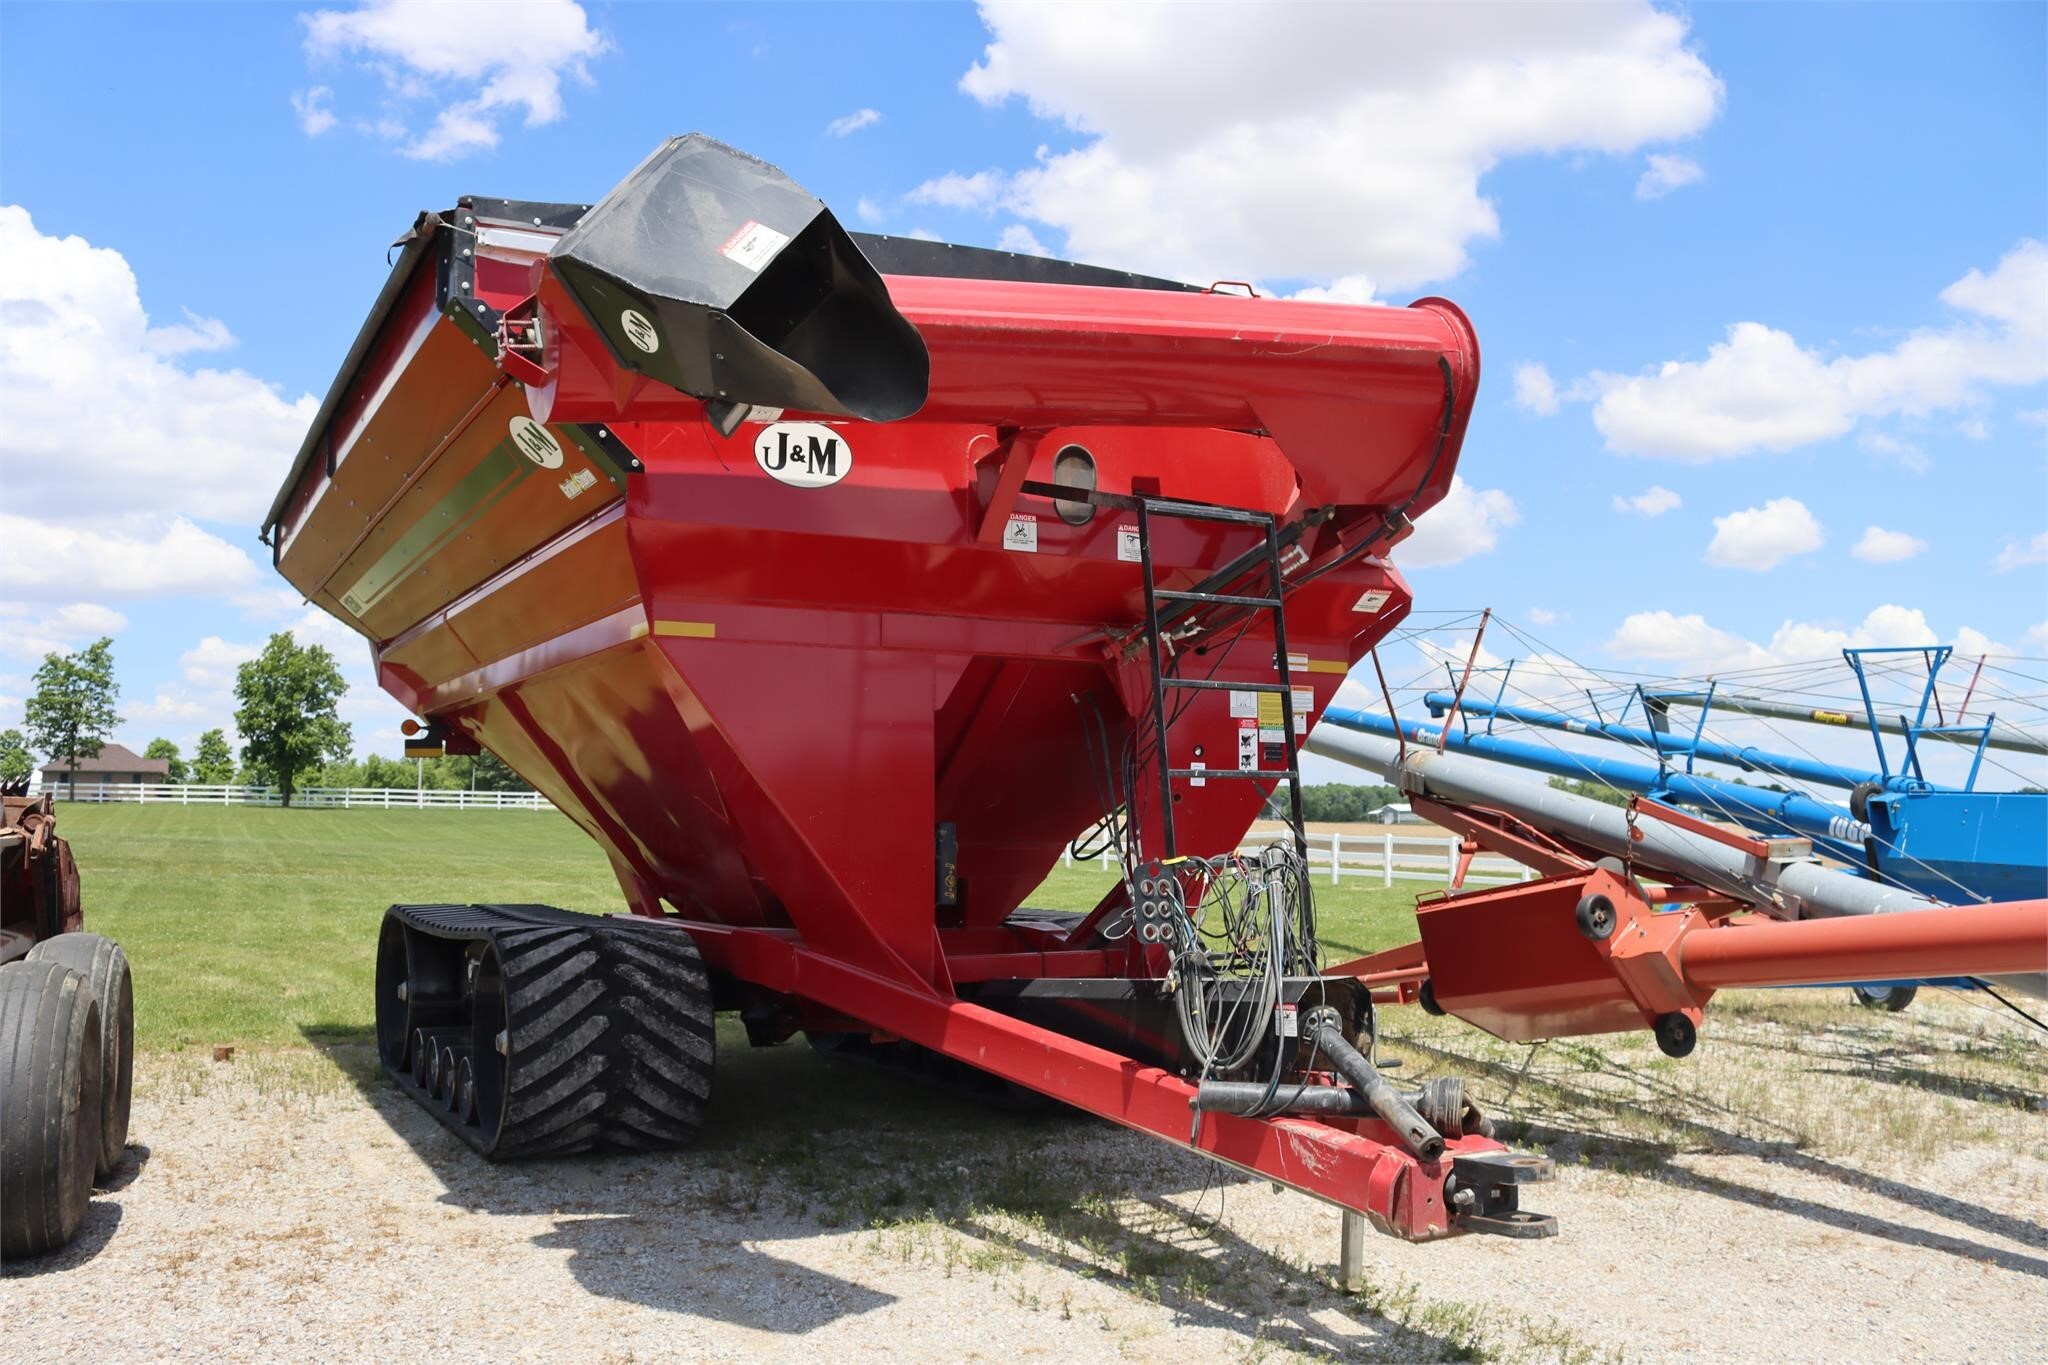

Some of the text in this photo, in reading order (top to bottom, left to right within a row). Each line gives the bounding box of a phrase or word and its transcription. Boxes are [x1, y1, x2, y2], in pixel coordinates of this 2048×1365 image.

[628, 311, 653, 351] J&M
[517, 421, 559, 464] J&M
[762, 432, 839, 477] J&M
[1009, 513, 1037, 523] DANGER
